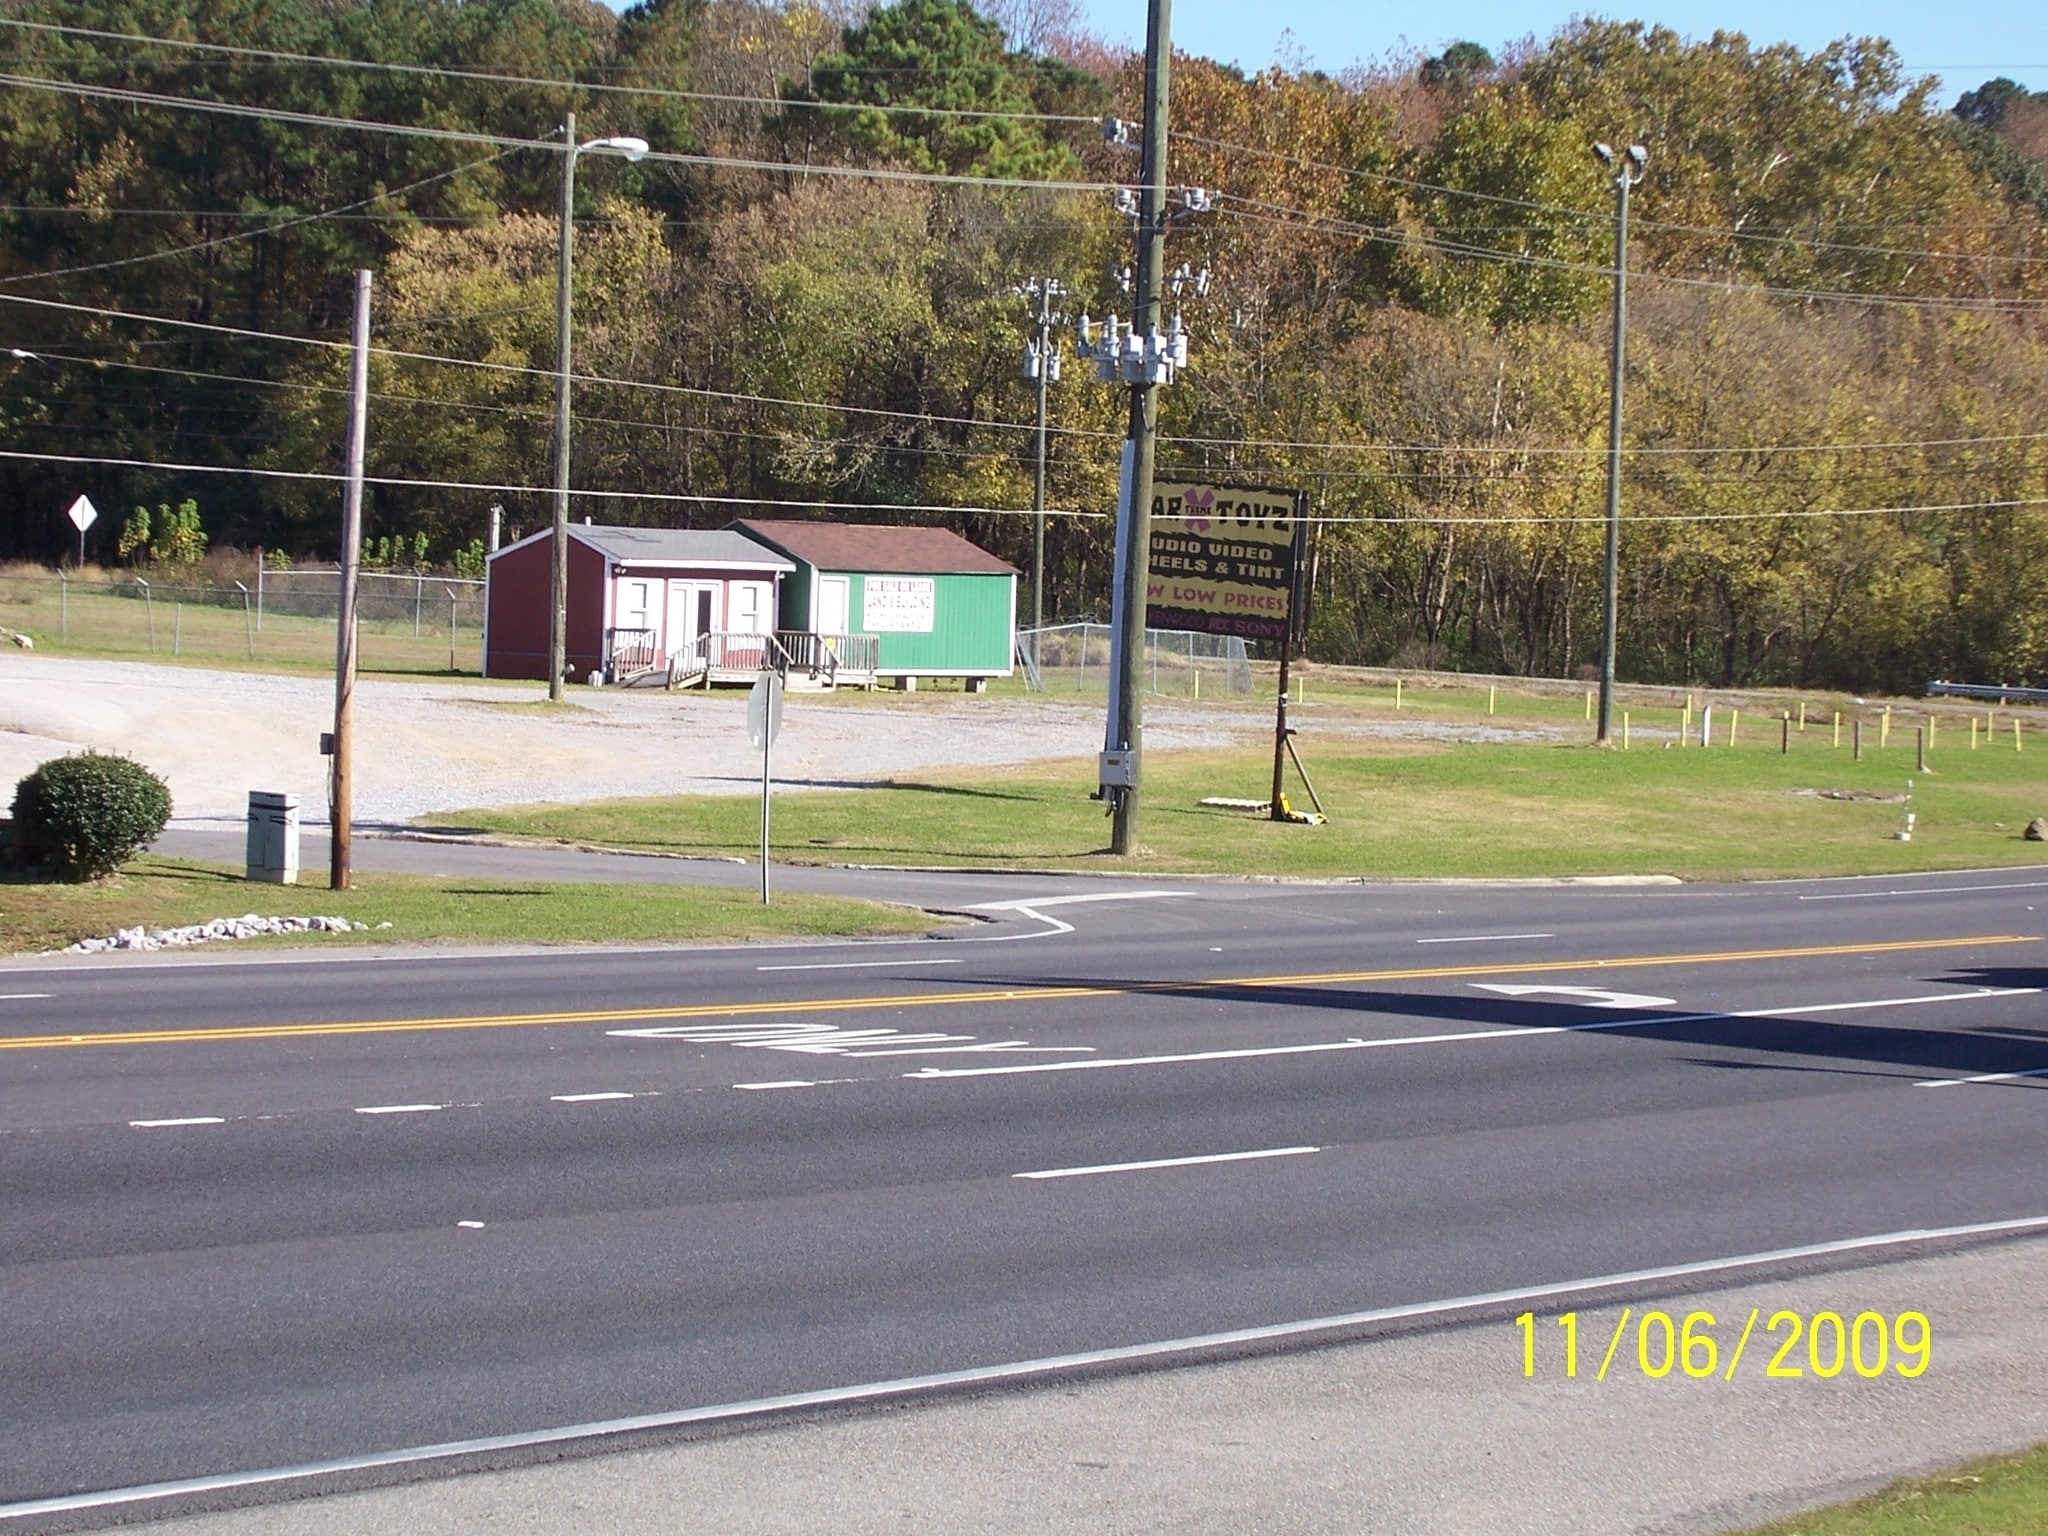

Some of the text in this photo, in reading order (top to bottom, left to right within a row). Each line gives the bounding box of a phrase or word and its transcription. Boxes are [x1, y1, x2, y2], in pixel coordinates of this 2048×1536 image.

[1152, 496, 1181, 521] AR
[1217, 500, 1289, 532] TOYZ
[1152, 538, 1273, 561] UDIO VIDEO
[1150, 555, 1285, 580] HEELS & TINT
[1173, 586, 1216, 604] LOW
[1224, 592, 1284, 611] PRICES
[1235, 620, 1286, 637] SONY
[605, 1023, 1097, 1057] ONLY
